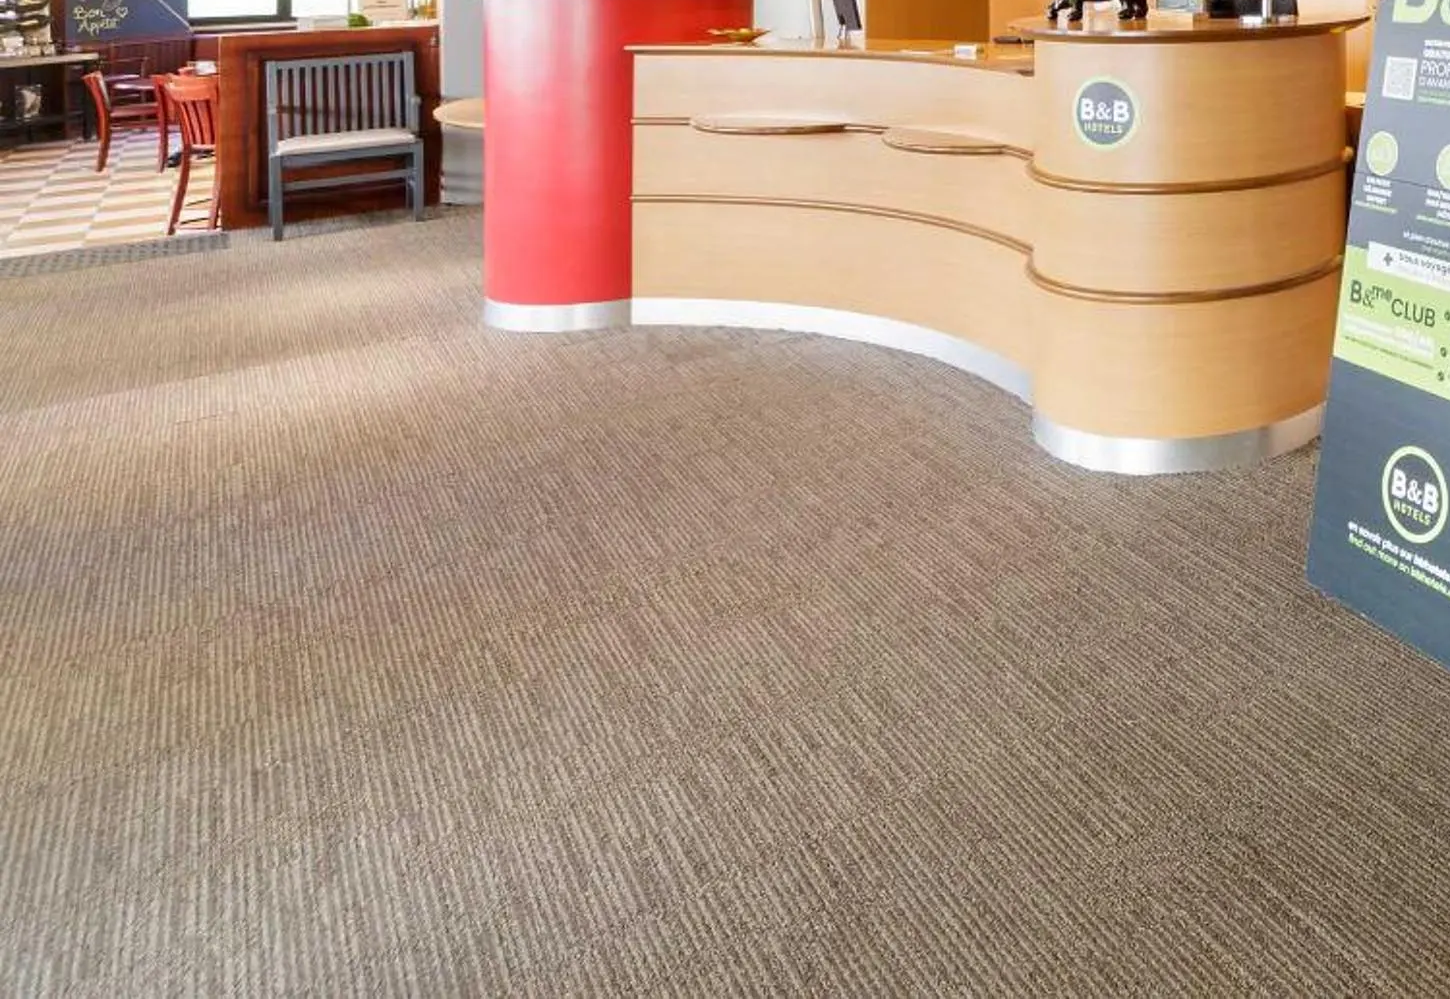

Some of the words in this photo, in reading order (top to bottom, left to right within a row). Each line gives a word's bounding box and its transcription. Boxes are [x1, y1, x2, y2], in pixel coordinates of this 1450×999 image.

[1081, 97, 1129, 122] B&B
[1391, 298, 1435, 328] CLUB
[1391, 467, 1439, 514] B&B
[1393, 501, 1433, 526] HOTELS
